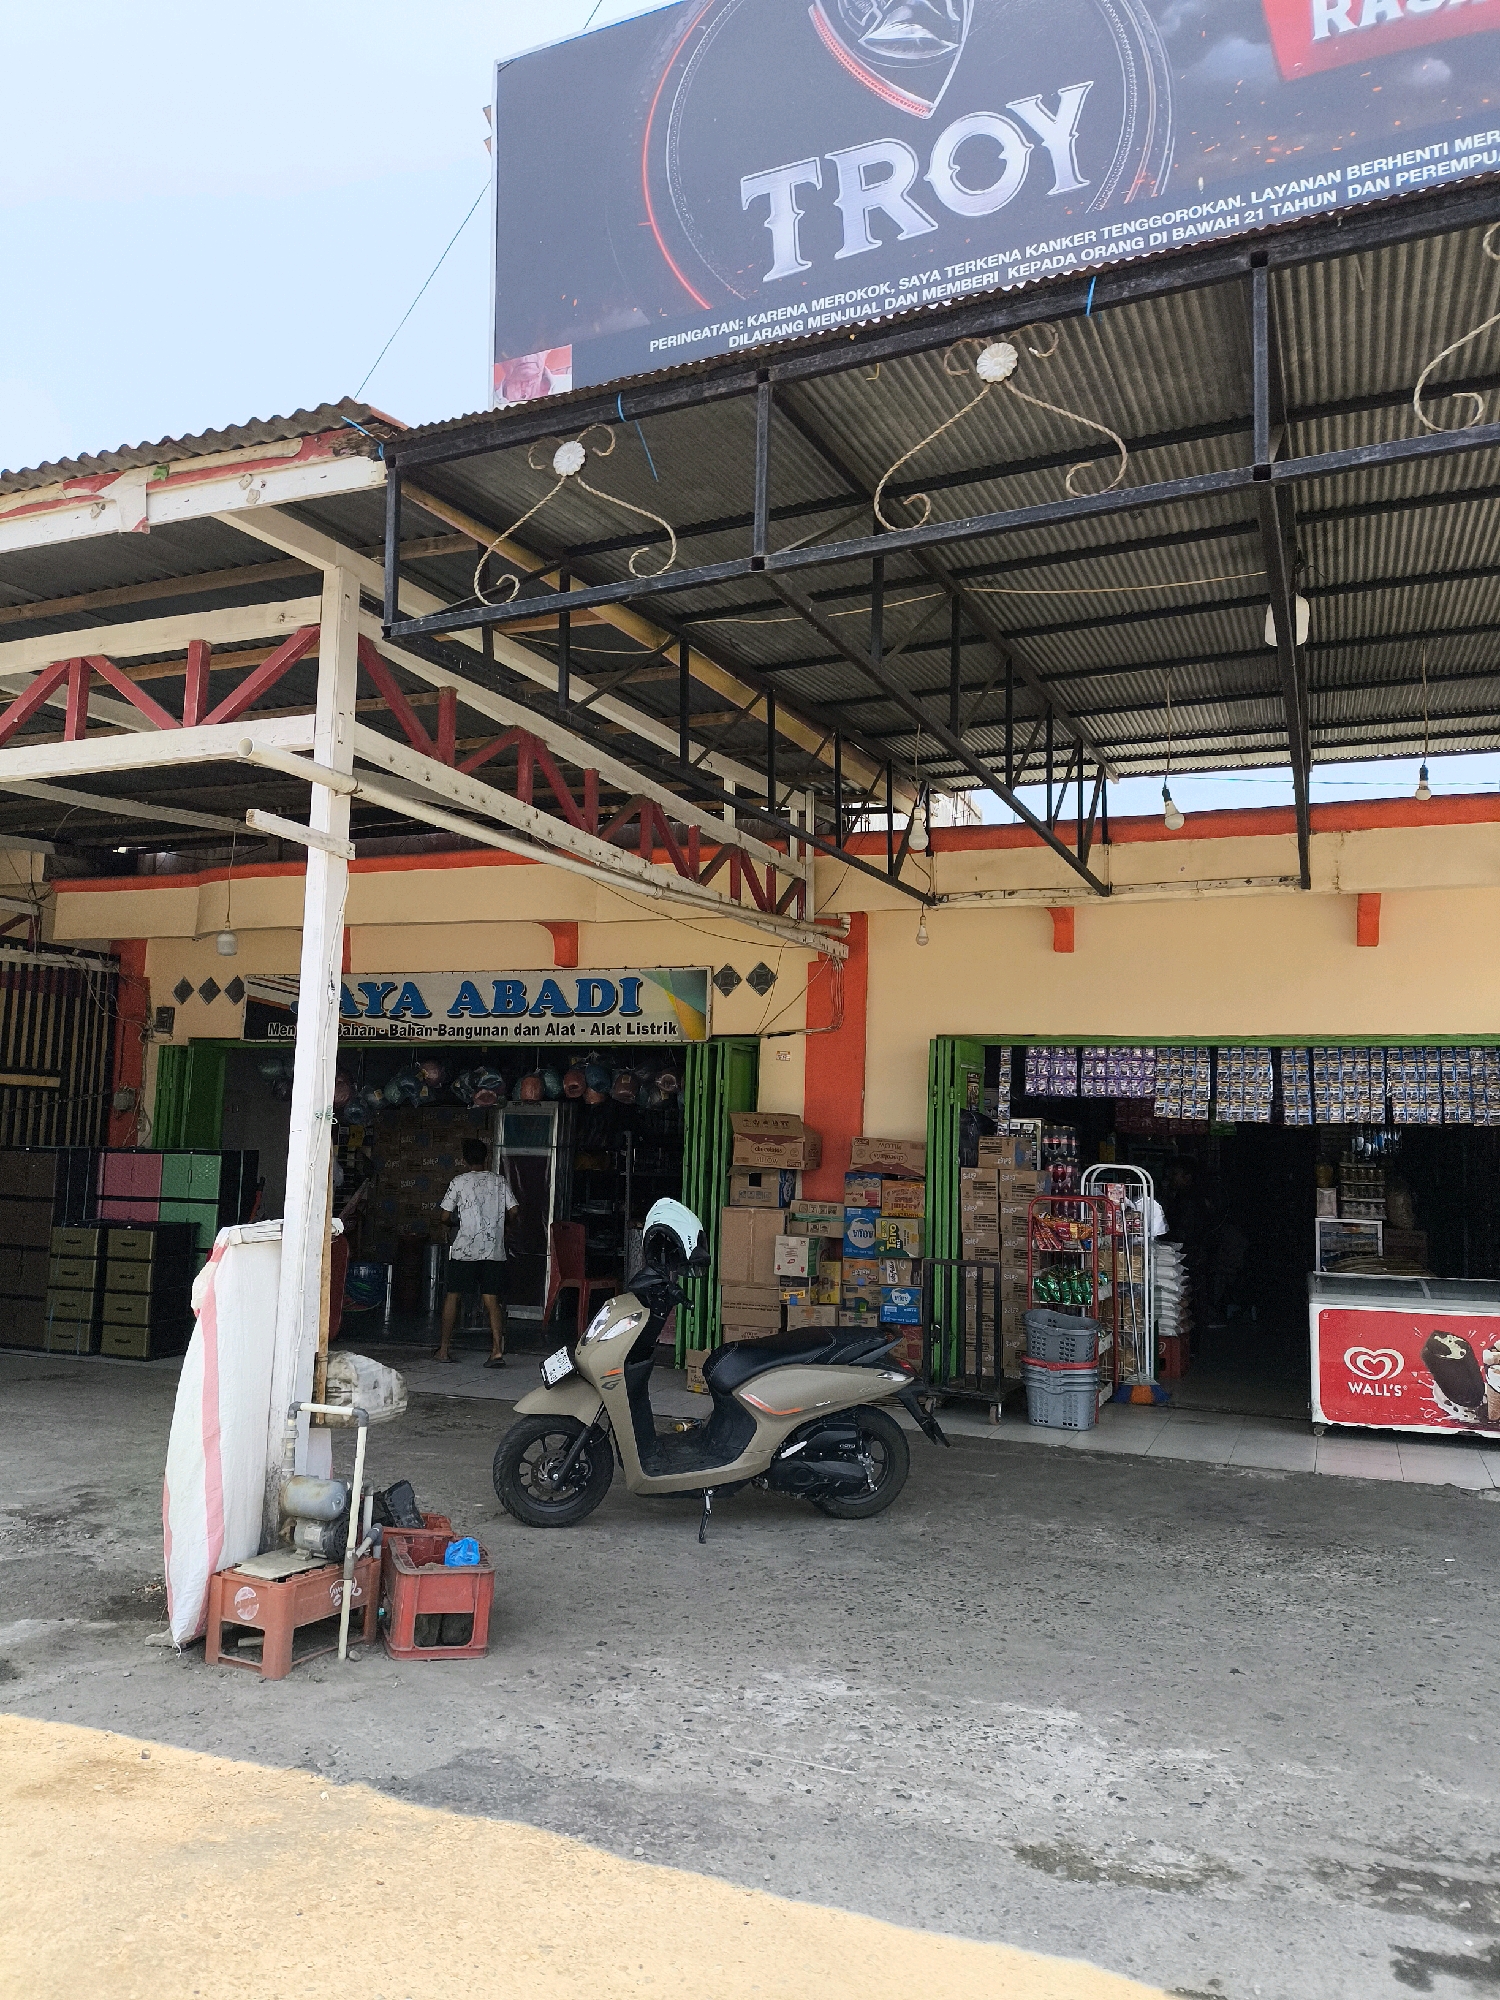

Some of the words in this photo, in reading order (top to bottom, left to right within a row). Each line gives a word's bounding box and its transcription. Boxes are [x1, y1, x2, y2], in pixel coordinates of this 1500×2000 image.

[740, 81, 1094, 282] TROY
[649, 317, 745, 353] PERINGATAN:
[747, 302, 809, 328] KARENA
[811, 280, 896, 312] MEROKOK,
[899, 269, 942, 290] SAYA
[944, 248, 1022, 279] TERKENA
[1025, 230, 1097, 259] KANKER
[1100, 194, 1247, 240] TENGGOROKAN.
[1251, 169, 1342, 205] LAYANAN
[1346, 141, 1449, 181] BERHENTI
[728, 319, 804, 349] DILARANG
[807, 302, 881, 329] MENJUAL
[884, 291, 918, 311] DAN
[922, 270, 999, 301] MEMBERI
[1007, 252, 1077, 280] KEPADA
[1080, 236, 1145, 261] ORANG
[1149, 229, 1168, 247] DI
[1172, 213, 1240, 241] BAWAH
[1243, 207, 1264, 225] 21
[1269, 189, 1337, 217] TAHUN
[1347, 175, 1391, 199] DAN
[290, 981, 432, 1018] AYA
[446, 976, 643, 1018] ABADI
[513, 1022, 541, 1037] dan
[544, 1021, 577, 1037] Alat
[590, 1021, 622, 1037] Alat
[626, 1021, 678, 1036] Listrik
[852, 1229, 874, 1239] AQUA
[886, 1223, 898, 1251] Taro
[1347, 1381, 1402, 1397] WALL'S
